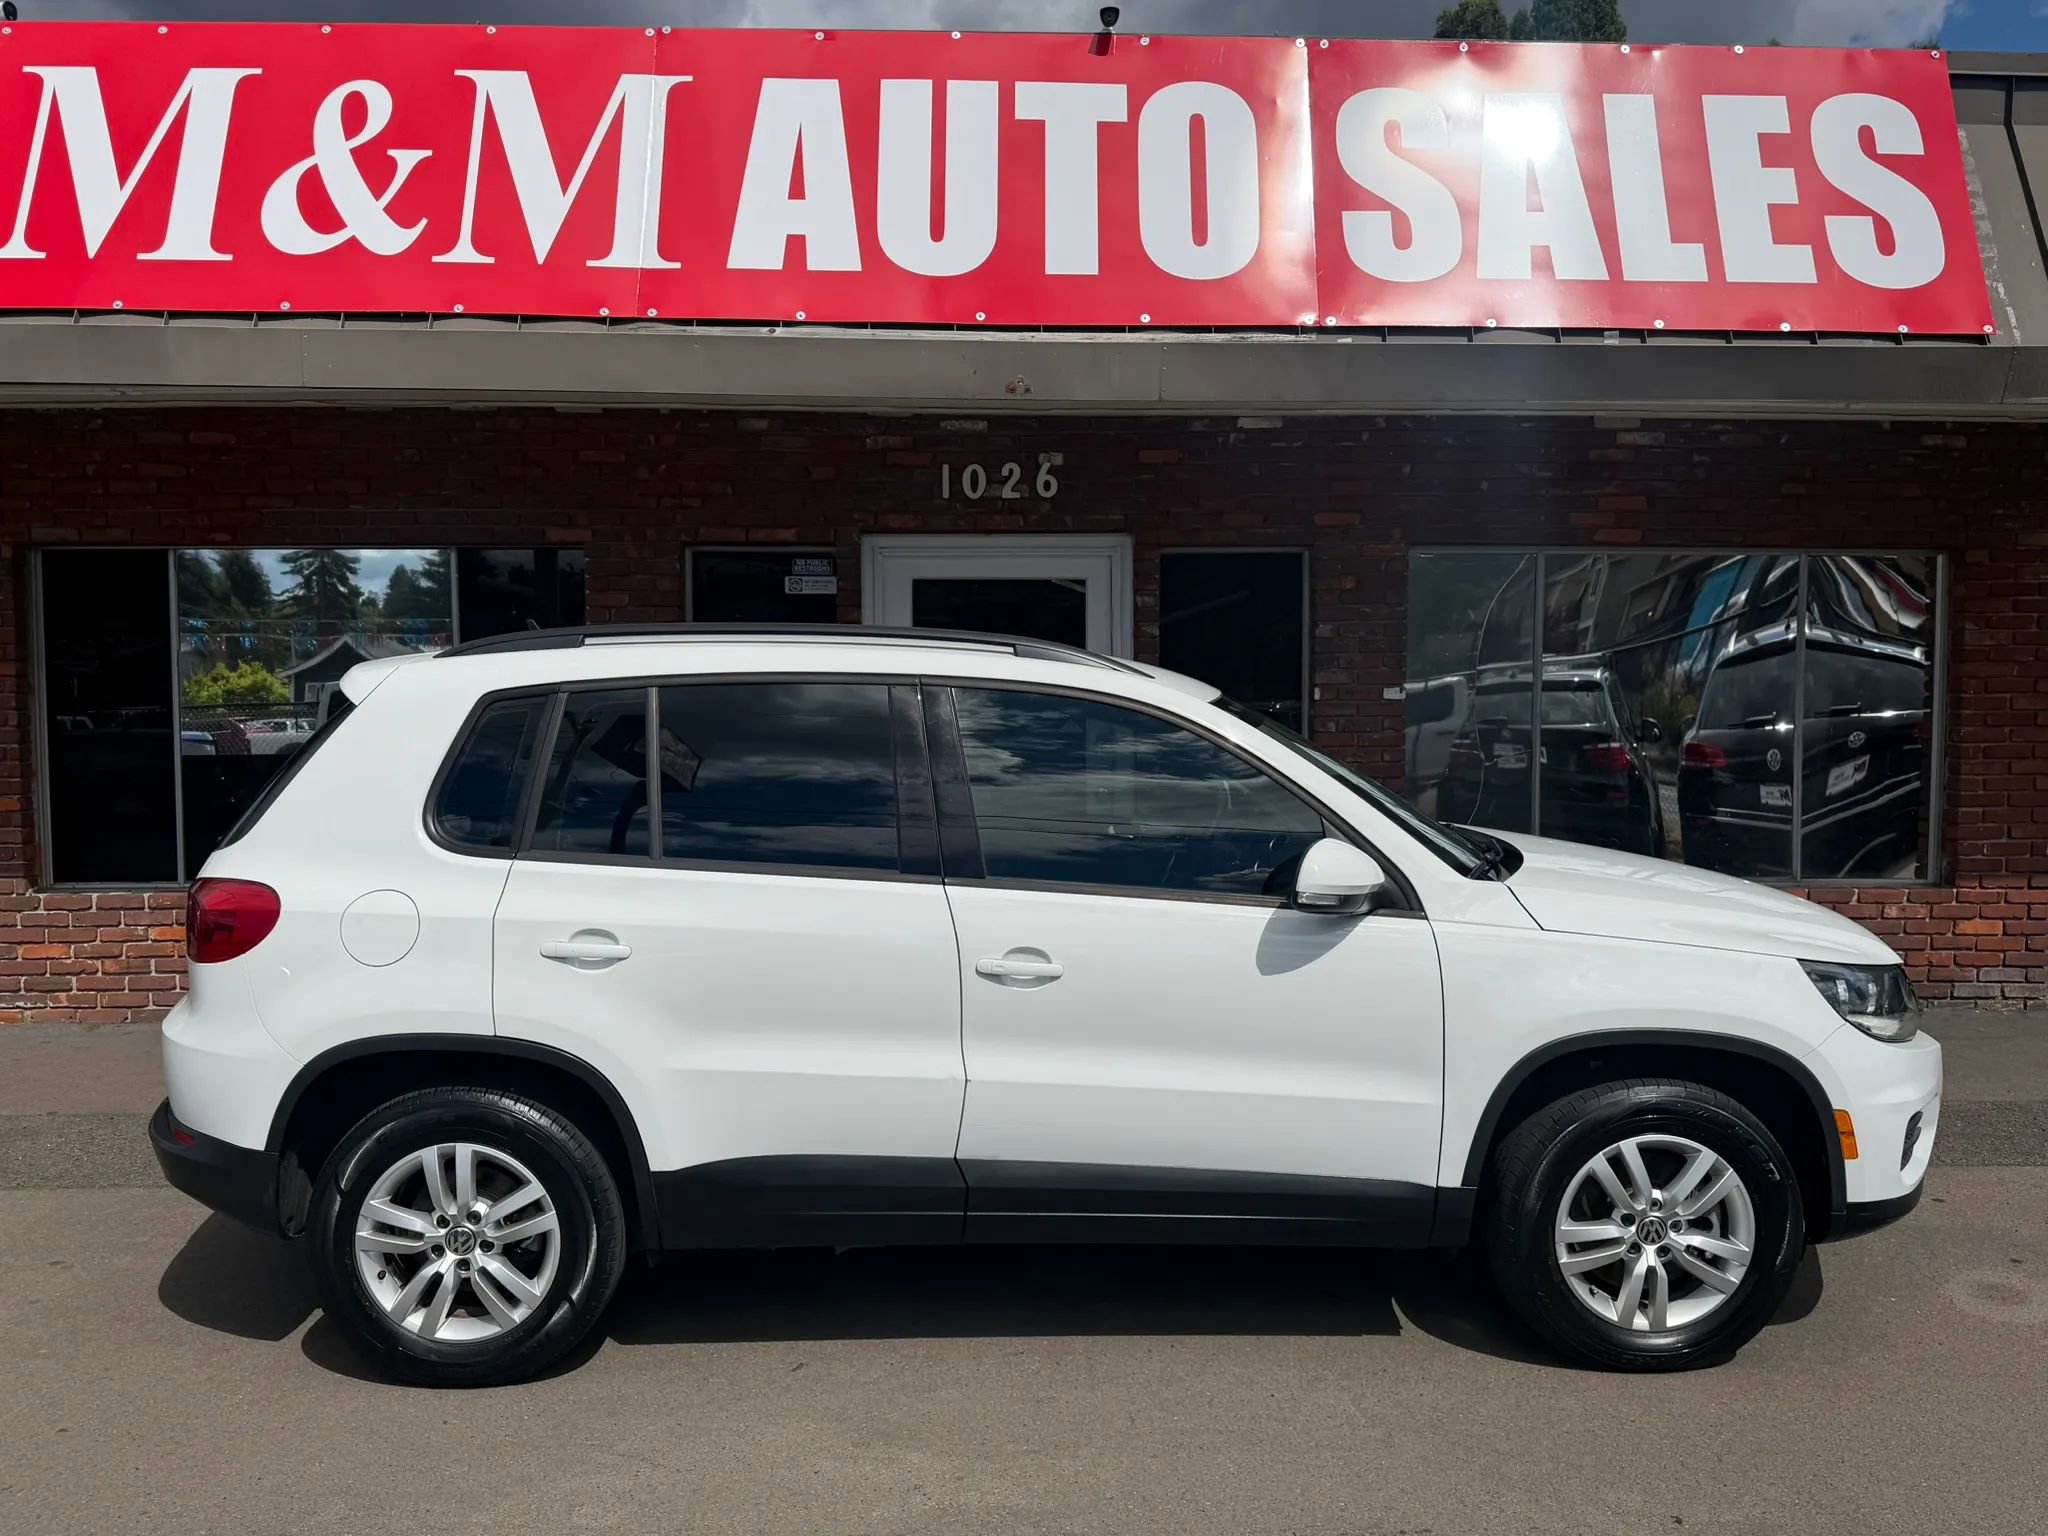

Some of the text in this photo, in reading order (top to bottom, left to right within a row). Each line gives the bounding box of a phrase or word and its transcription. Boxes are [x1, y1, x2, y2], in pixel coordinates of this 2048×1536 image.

[0, 66, 1946, 289] M&M AUTO SALES
[941, 461, 1059, 500] 1026
